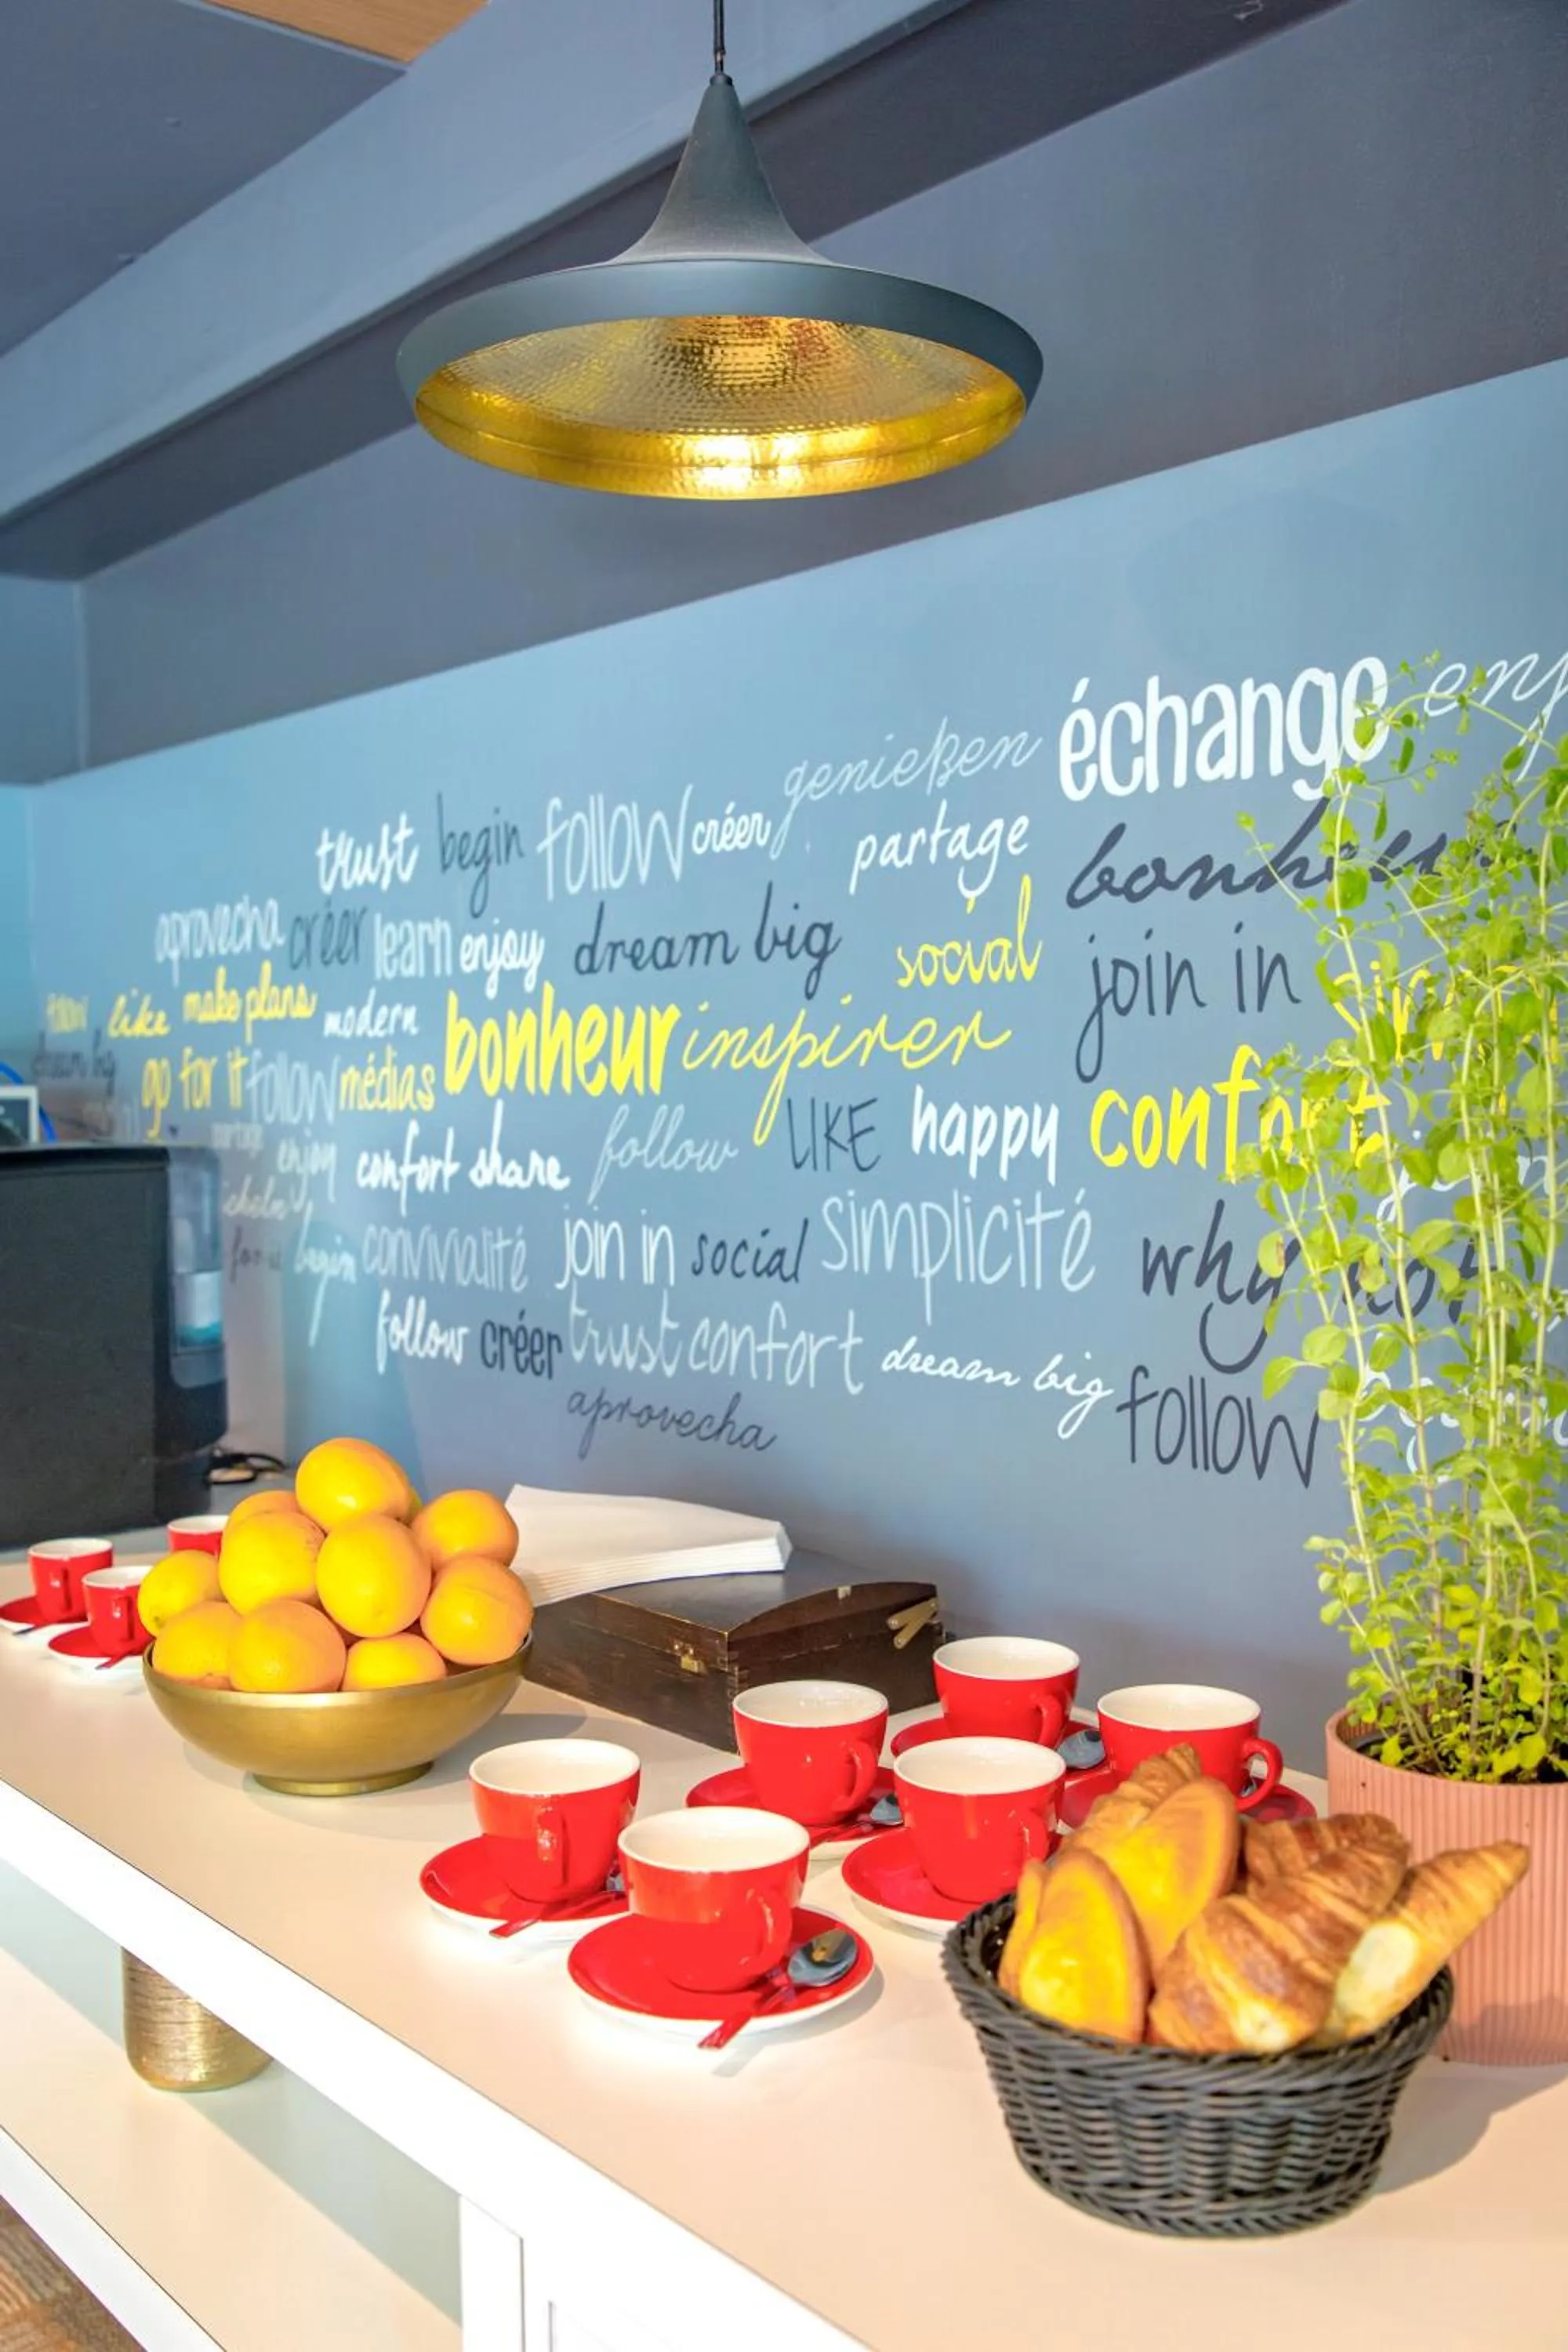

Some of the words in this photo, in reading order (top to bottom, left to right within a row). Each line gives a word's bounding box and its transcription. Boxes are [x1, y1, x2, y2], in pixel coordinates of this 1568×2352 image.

[1059, 657, 1390, 801] échange
[692, 801, 772, 856] créer
[768, 715, 1044, 862] genießen
[315, 811, 419, 895] trust
[437, 790, 526, 919] begin
[848, 797, 1030, 898] partage
[154, 894, 286, 988] aprovecha
[289, 899, 368, 971] créer
[373, 913, 452, 981] learn
[459, 919, 546, 1000] enjoy
[573, 901, 739, 977] dream
[754, 880, 843, 1001] big
[895, 873, 1044, 989] social
[107, 986, 172, 1040] like
[182, 964, 241, 1024] make
[245, 958, 318, 1047] plans
[323, 986, 419, 1039] modern
[442, 980, 682, 1099] bonheur
[1075, 921, 1207, 1084] join
[1234, 920, 1302, 1014] in
[142, 1058, 172, 1142] go
[179, 1047, 218, 1111] for
[227, 1045, 251, 1109] it
[338, 1044, 437, 1114] médias
[680, 993, 1012, 1147] inspirer
[355, 1118, 461, 1218] confort
[469, 1098, 571, 1190] share
[586, 1103, 740, 1206] follow
[911, 1083, 1059, 1188] happy
[554, 1203, 625, 1290] join
[641, 1207, 676, 1287] in
[690, 1218, 811, 1284] social
[820, 1186, 1096, 1327] simplicité
[1142, 1198, 1303, 1374] why
[375, 1287, 472, 1376] follow
[480, 1308, 564, 1381] créer
[568, 1279, 684, 1378] trust
[687, 1301, 865, 1396] confort
[567, 1387, 778, 1461] aprovecha
[881, 1336, 1022, 1388] dream
[1033, 1351, 1116, 1440] big
[1116, 1364, 1320, 1489] follow
